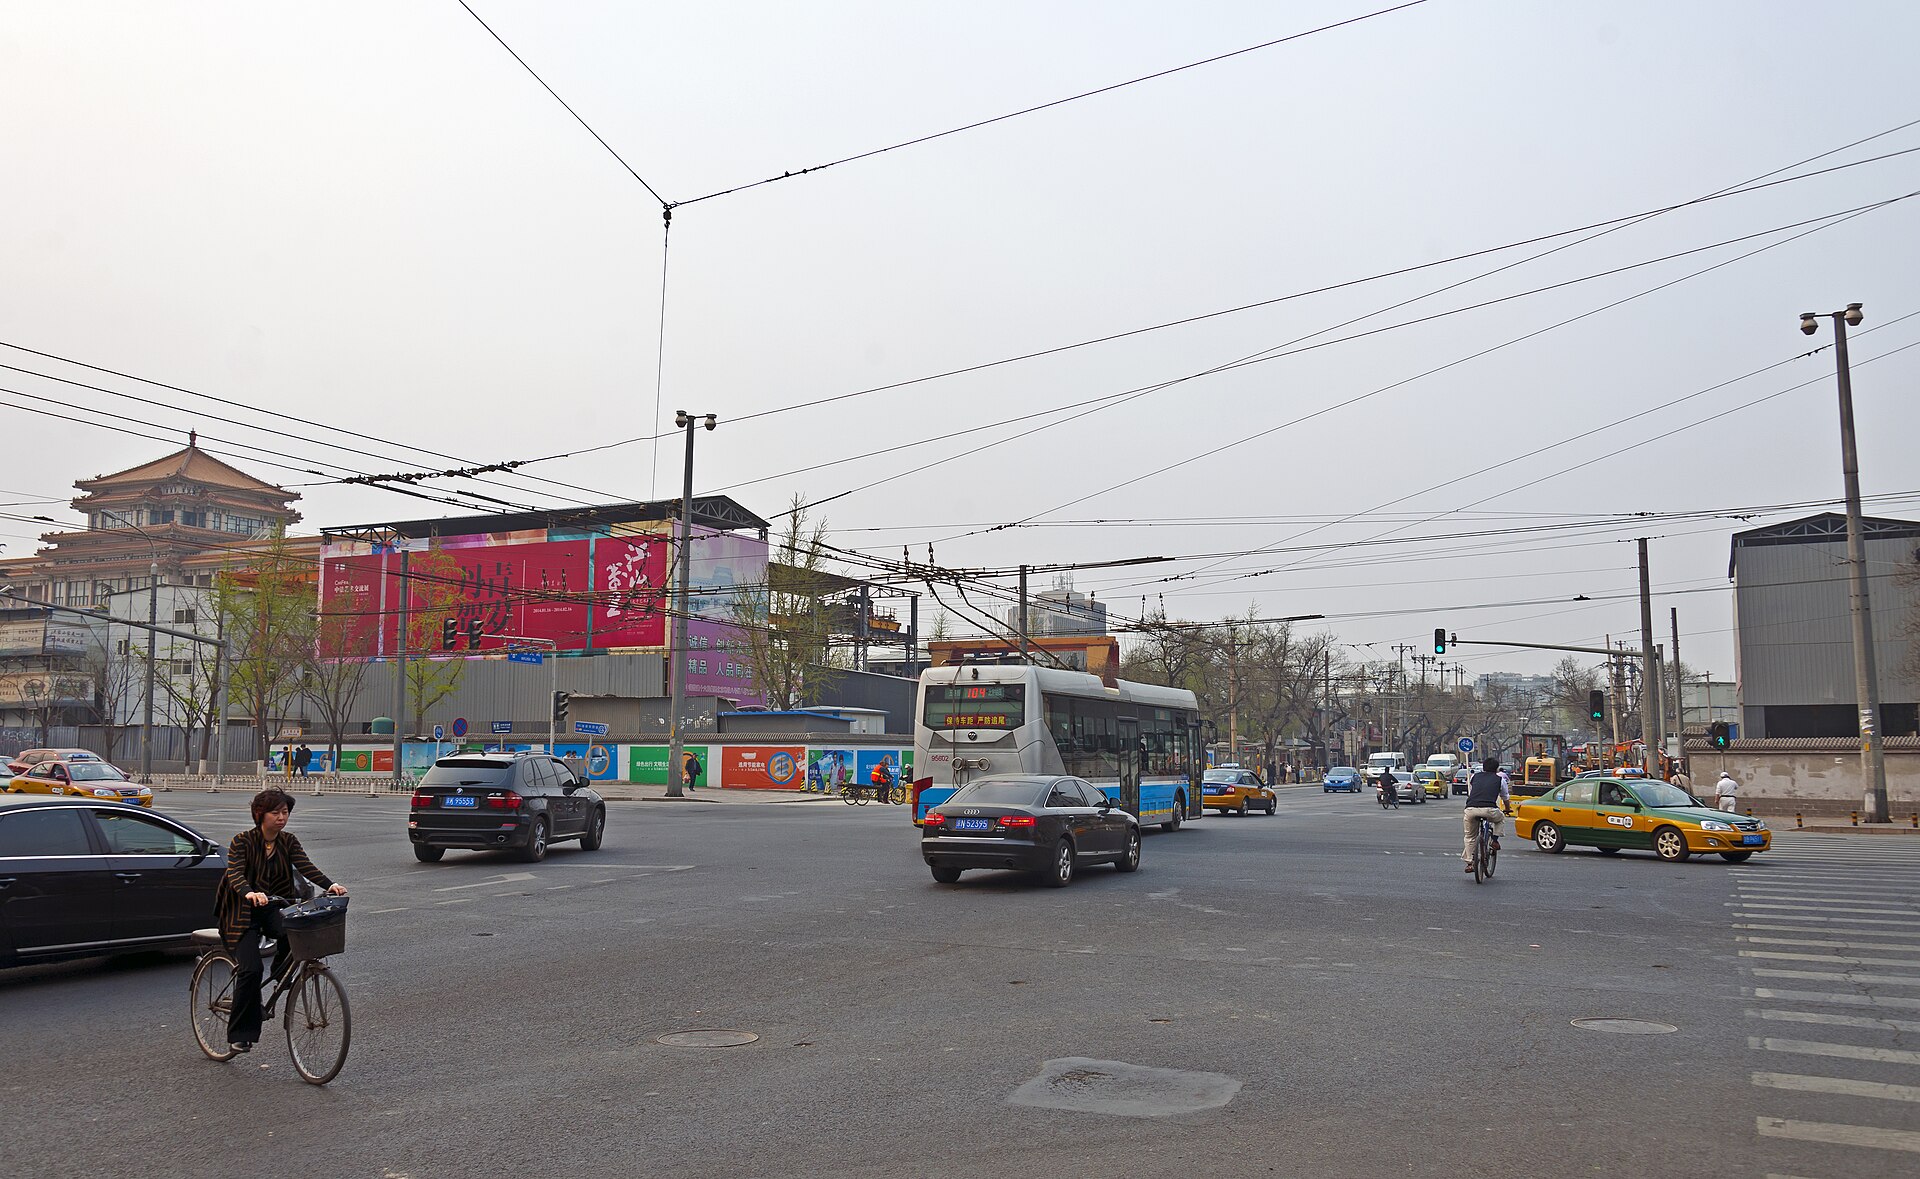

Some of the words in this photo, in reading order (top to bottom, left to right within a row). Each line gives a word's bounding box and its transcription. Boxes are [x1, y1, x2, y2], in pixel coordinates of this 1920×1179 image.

[459, 562, 513, 598] 丹青
[689, 635, 708, 649] 诚信
[688, 658, 707, 675] 精品
[716, 661, 752, 678] 人品同在
[967, 687, 986, 699] 104
[946, 716, 974, 725] 保持车距
[977, 716, 1005, 725] 严防追尾
